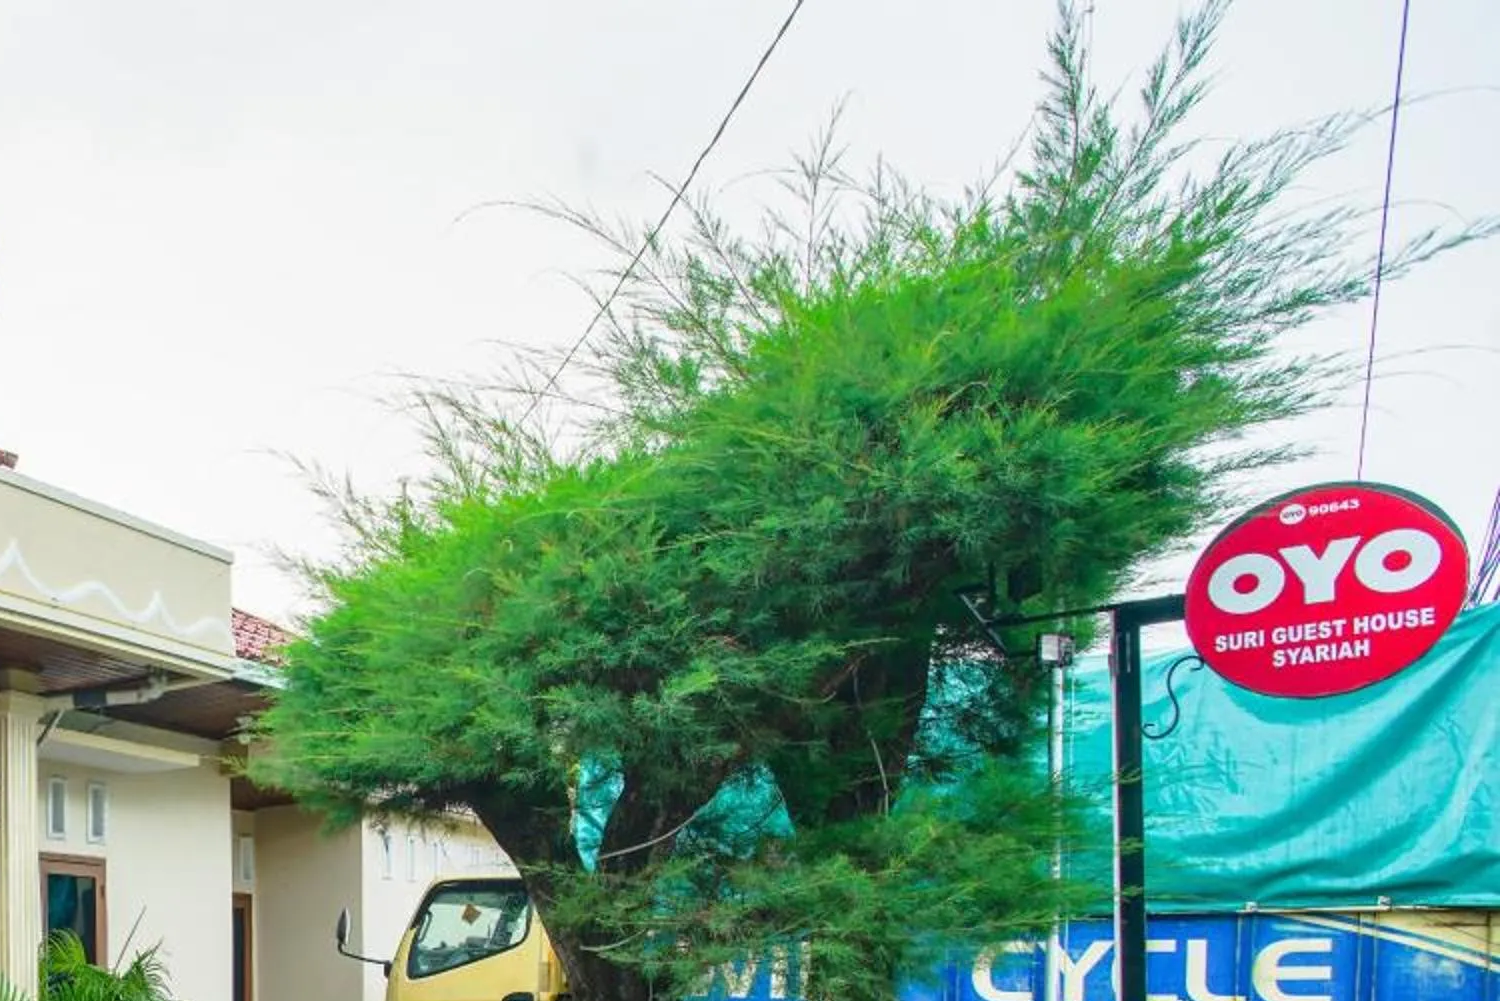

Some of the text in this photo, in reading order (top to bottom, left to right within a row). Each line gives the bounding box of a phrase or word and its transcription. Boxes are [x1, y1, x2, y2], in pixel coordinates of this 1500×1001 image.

[1207, 528, 1442, 615] OYO
[1214, 607, 1436, 653] SURI GUEST HOUSE
[1271, 639, 1371, 668] SYARIAH
